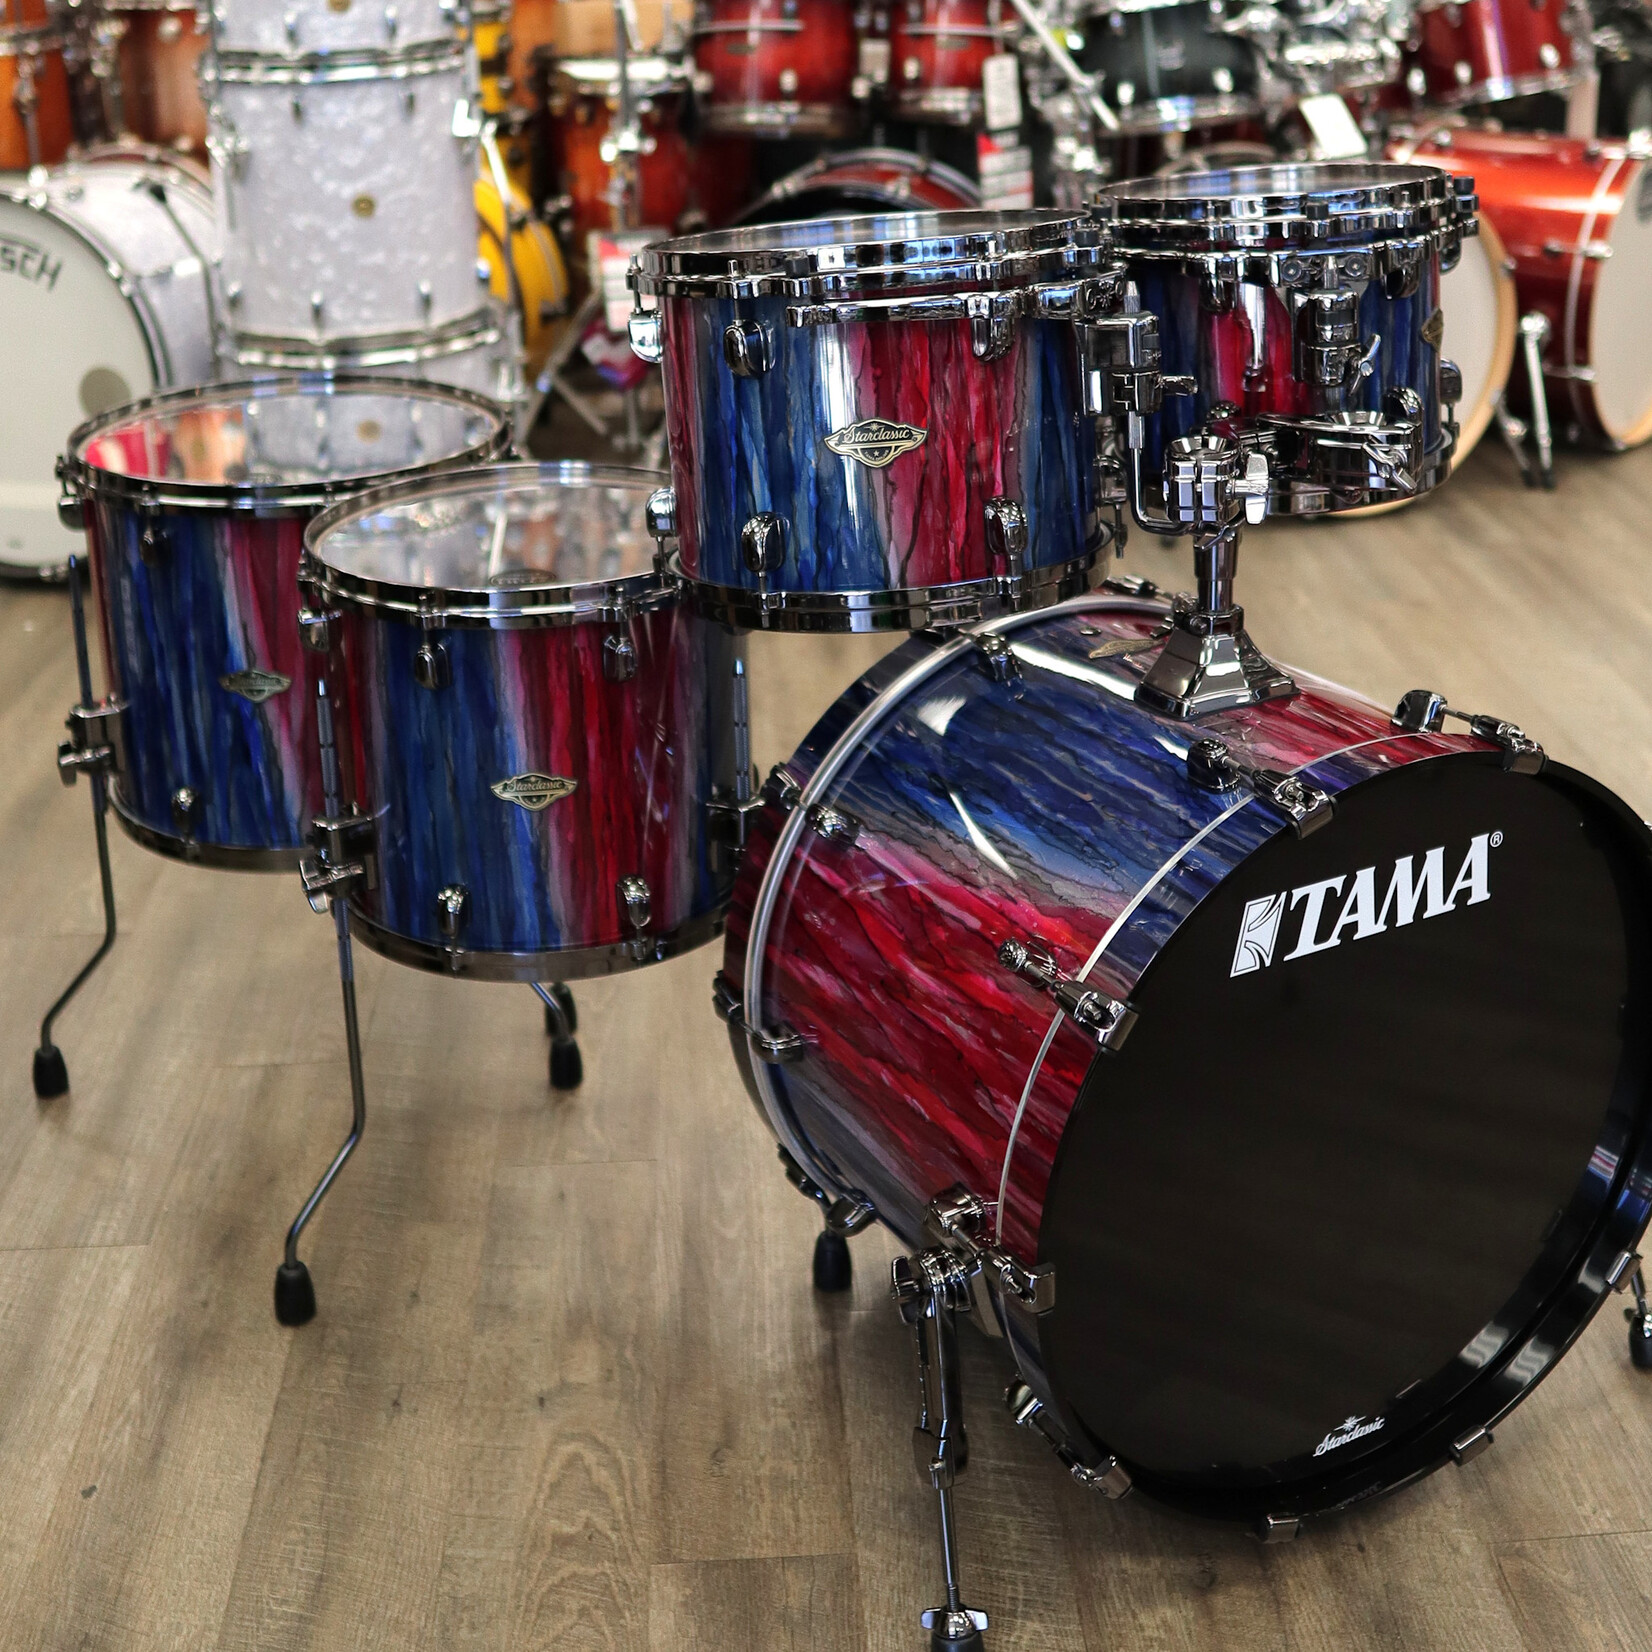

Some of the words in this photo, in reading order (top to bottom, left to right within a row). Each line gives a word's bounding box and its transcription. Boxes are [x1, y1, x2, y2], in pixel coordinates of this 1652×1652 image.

[0, 233, 62, 290] SCH
[842, 426, 910, 444] Starclassic
[1312, 1416, 1386, 1457] Starclassic
